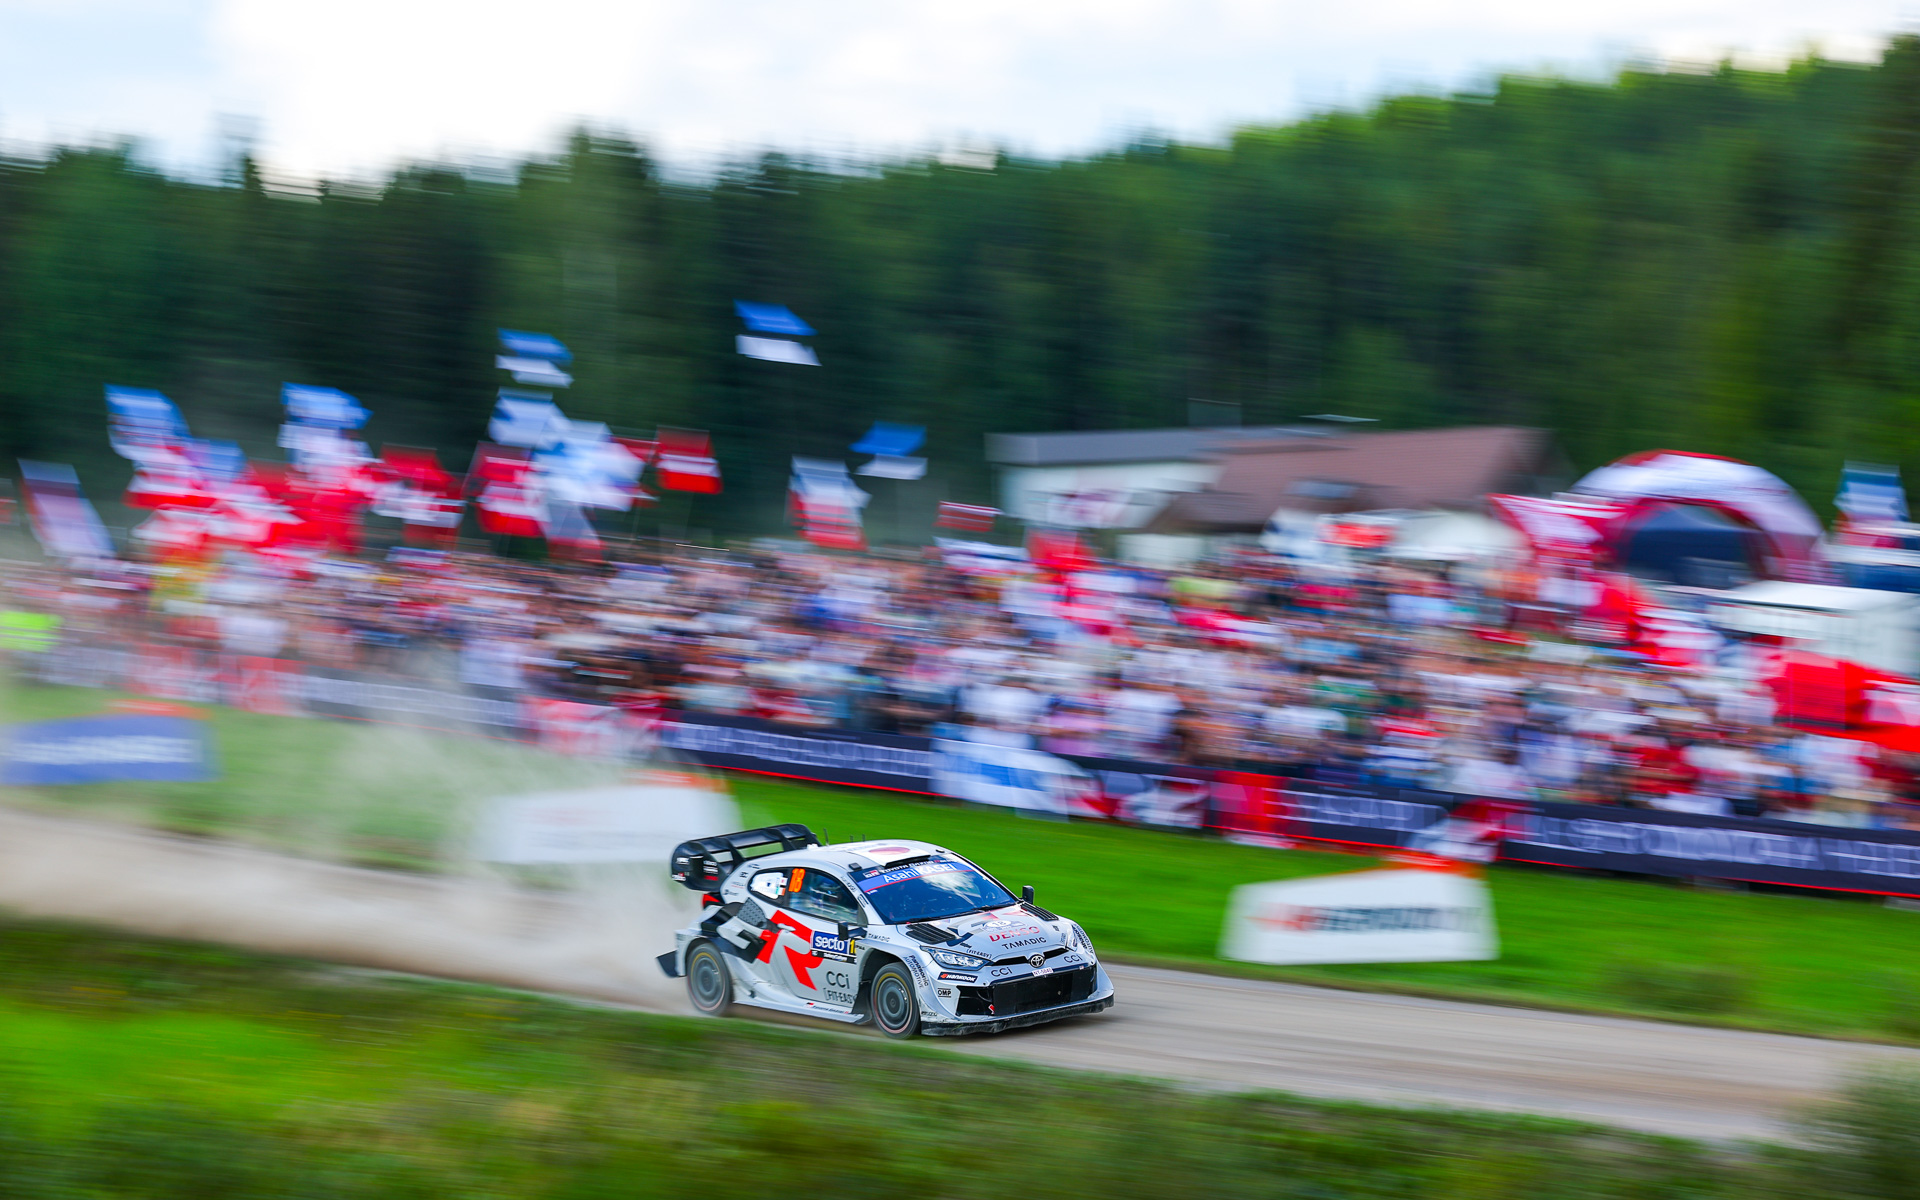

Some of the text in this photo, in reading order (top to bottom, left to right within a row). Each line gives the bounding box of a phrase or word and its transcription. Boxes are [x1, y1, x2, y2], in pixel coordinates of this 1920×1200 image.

[789, 868, 806, 893] 18
[989, 926, 1040, 942] DENSO
[815, 935, 845, 951] secto
[1002, 937, 1047, 950] TAMADIC
[908, 954, 929, 987] Panasonic
